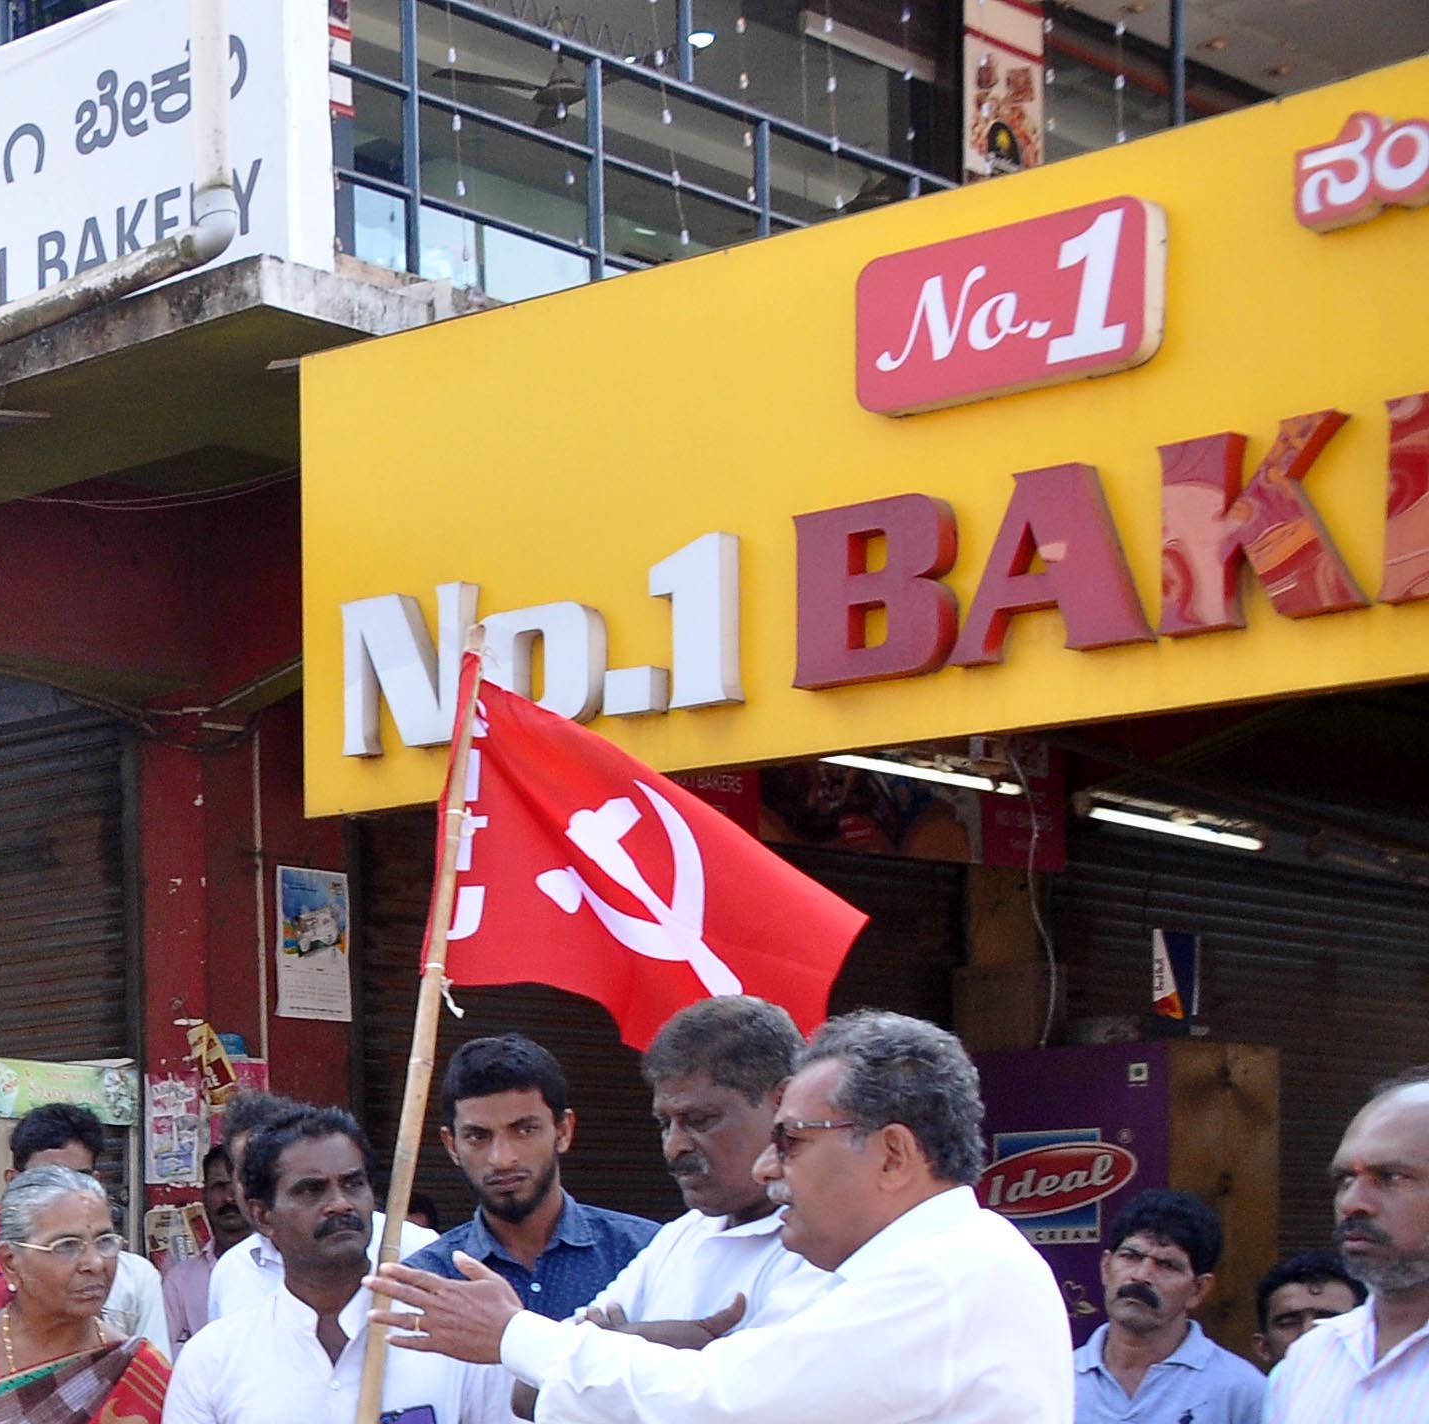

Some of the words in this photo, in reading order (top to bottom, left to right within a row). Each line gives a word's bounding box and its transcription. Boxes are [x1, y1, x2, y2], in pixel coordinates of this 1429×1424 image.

[37, 158, 262, 290] BAKEY
[877, 209, 1129, 374] No.1
[341, 530, 747, 760] No.1
[988, 1153, 1115, 1206] Ideal
[1035, 1229, 1100, 1241] CREAM
